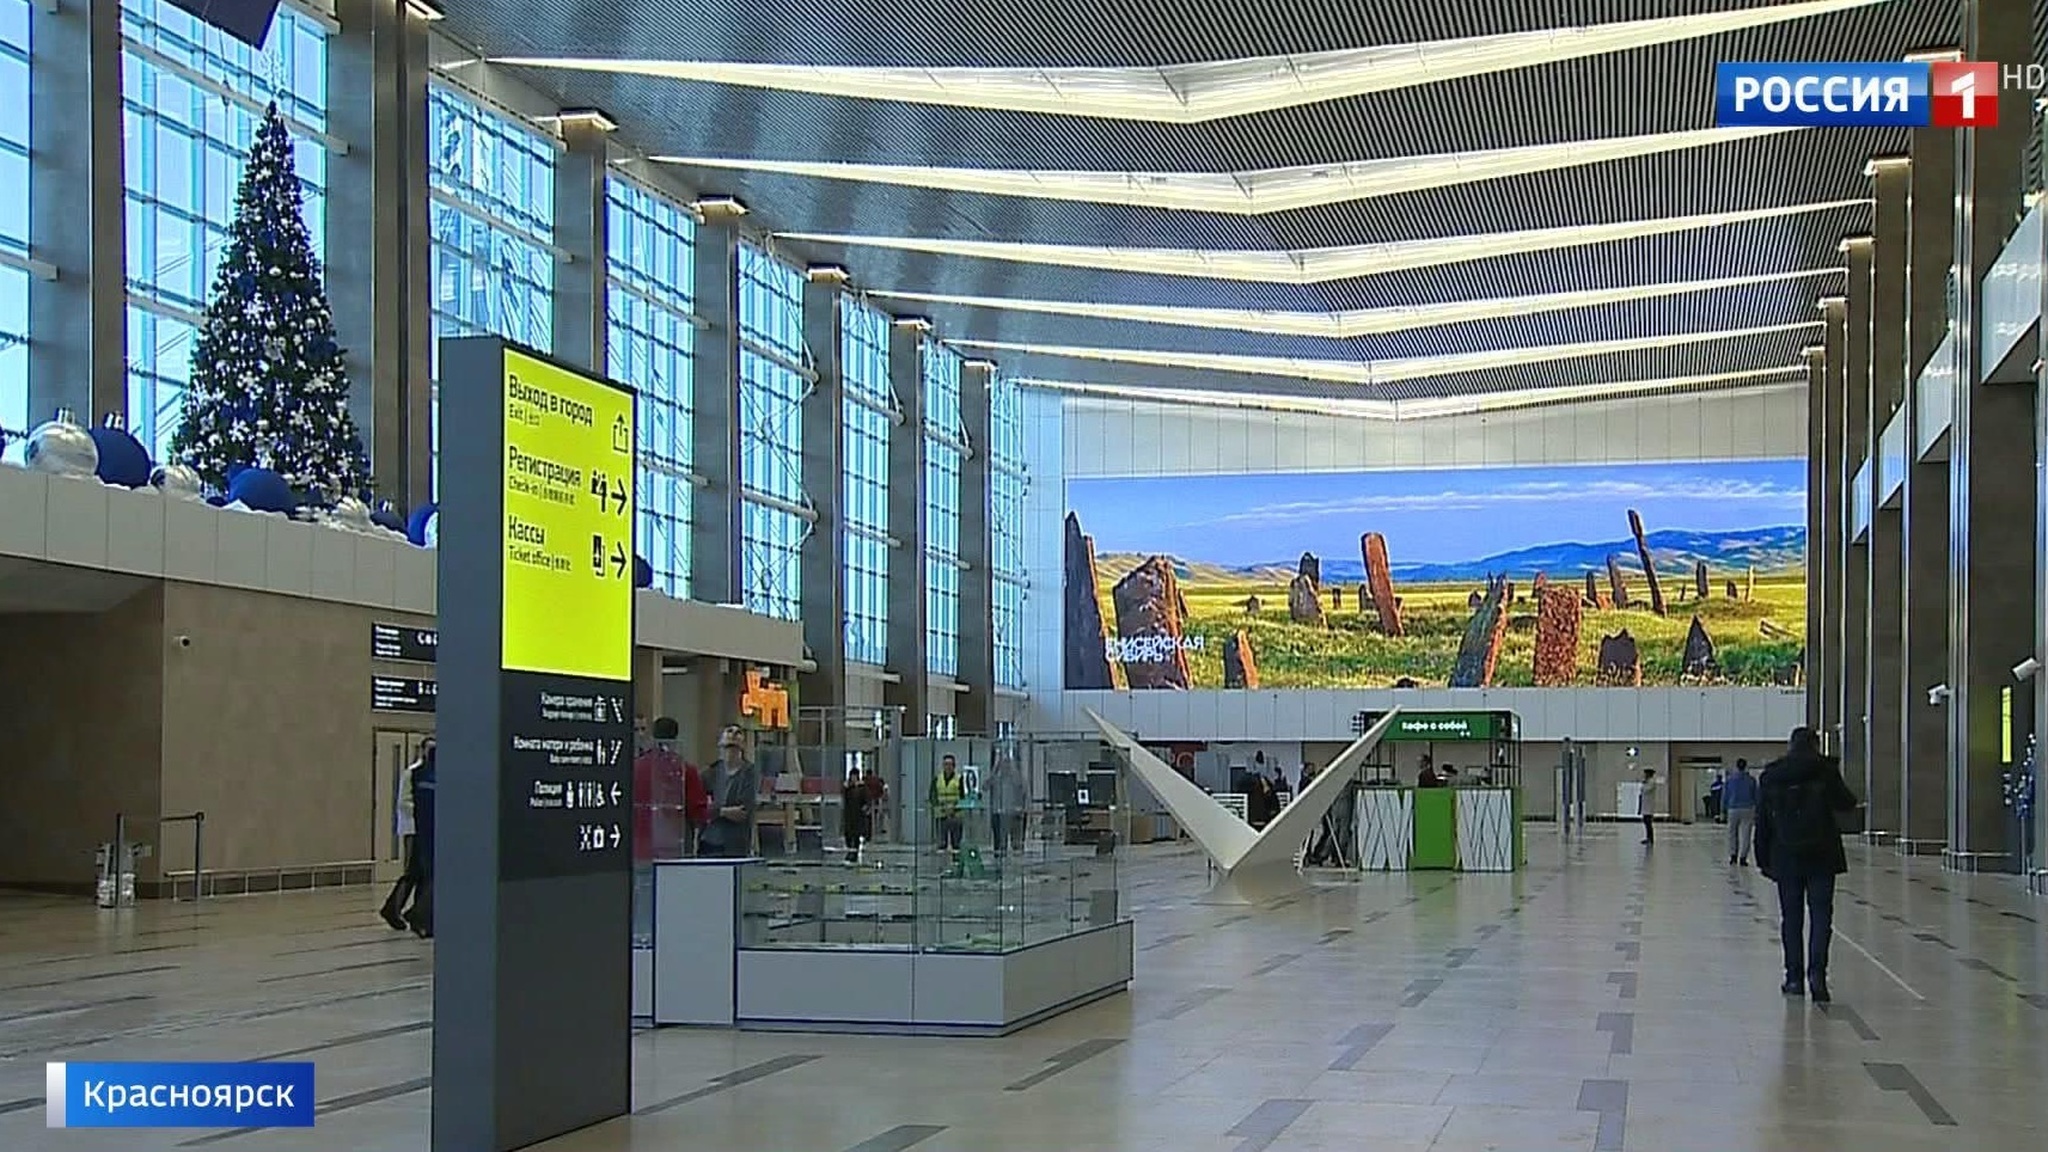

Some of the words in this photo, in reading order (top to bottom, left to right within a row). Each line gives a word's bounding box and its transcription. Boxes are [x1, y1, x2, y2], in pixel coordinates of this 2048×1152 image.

[509, 374, 548, 413] Выход
[551, 395, 558, 412] в
[560, 398, 592, 427] город
[509, 403, 523, 421] Exit
[509, 445, 581, 487] Регистрация
[509, 515, 545, 545] Кассы
[509, 545, 531, 562] Ticket
[532, 551, 550, 568] office
[1105, 635, 1204, 650] ЕНИСЕЙСКАЯ
[1105, 649, 1164, 662] СИБИРЬ
